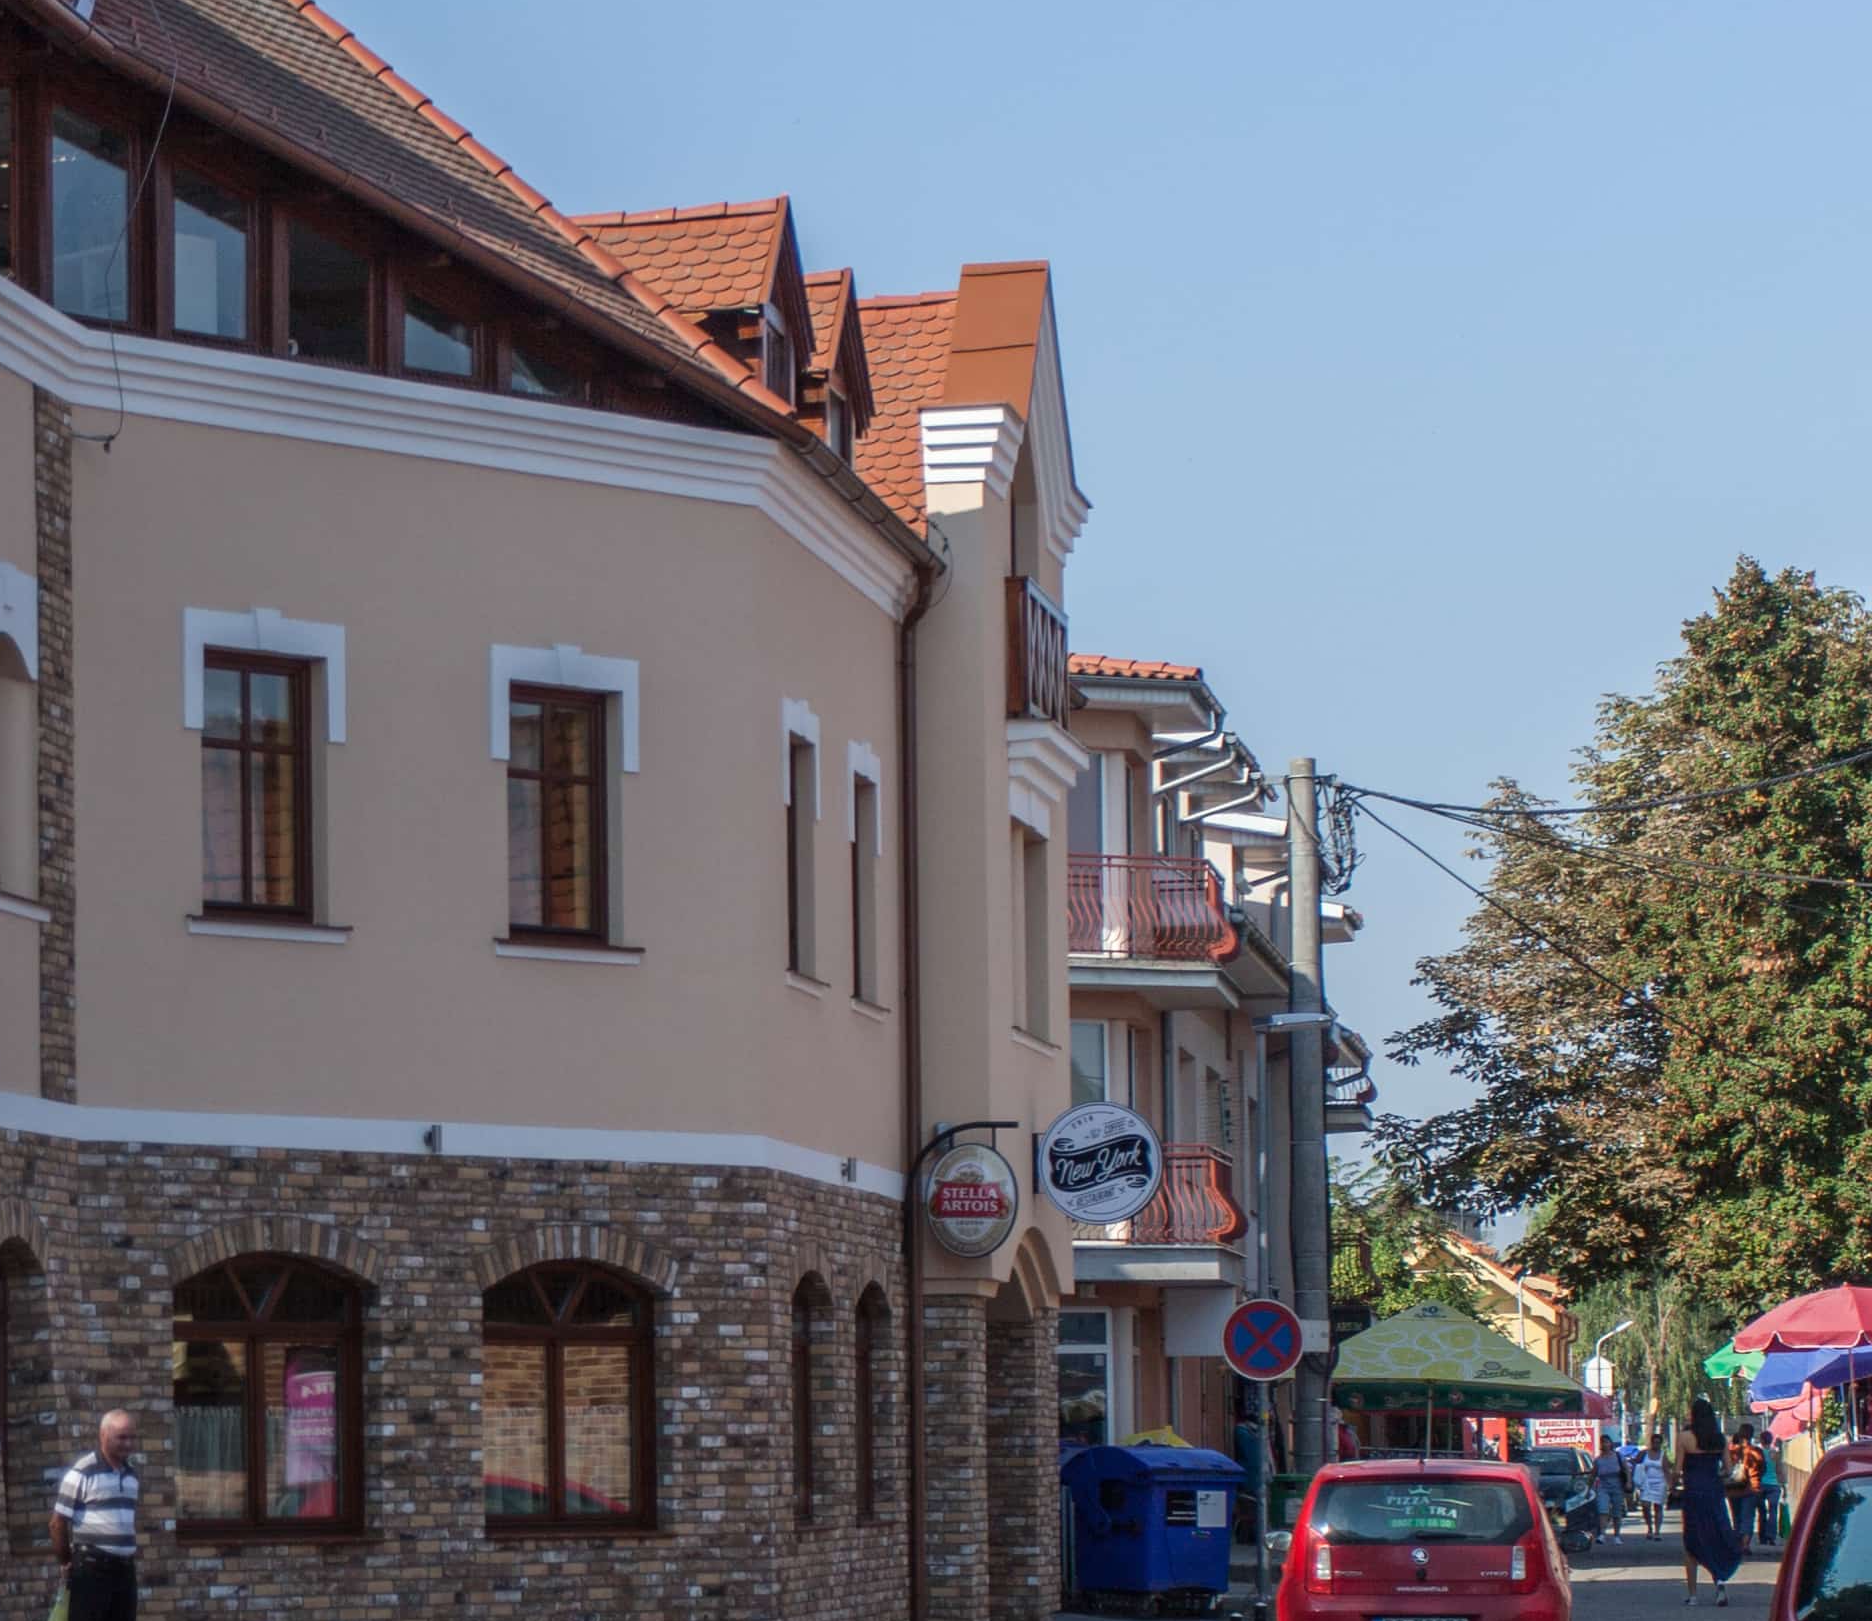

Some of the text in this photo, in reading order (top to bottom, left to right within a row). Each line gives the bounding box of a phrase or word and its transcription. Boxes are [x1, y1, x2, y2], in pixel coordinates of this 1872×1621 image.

[1055, 1139, 1143, 1186] New York
[943, 1187, 998, 1199] STELLA
[942, 1200, 999, 1212] ARTOIS
[1386, 1495, 1430, 1506] PIZZA
